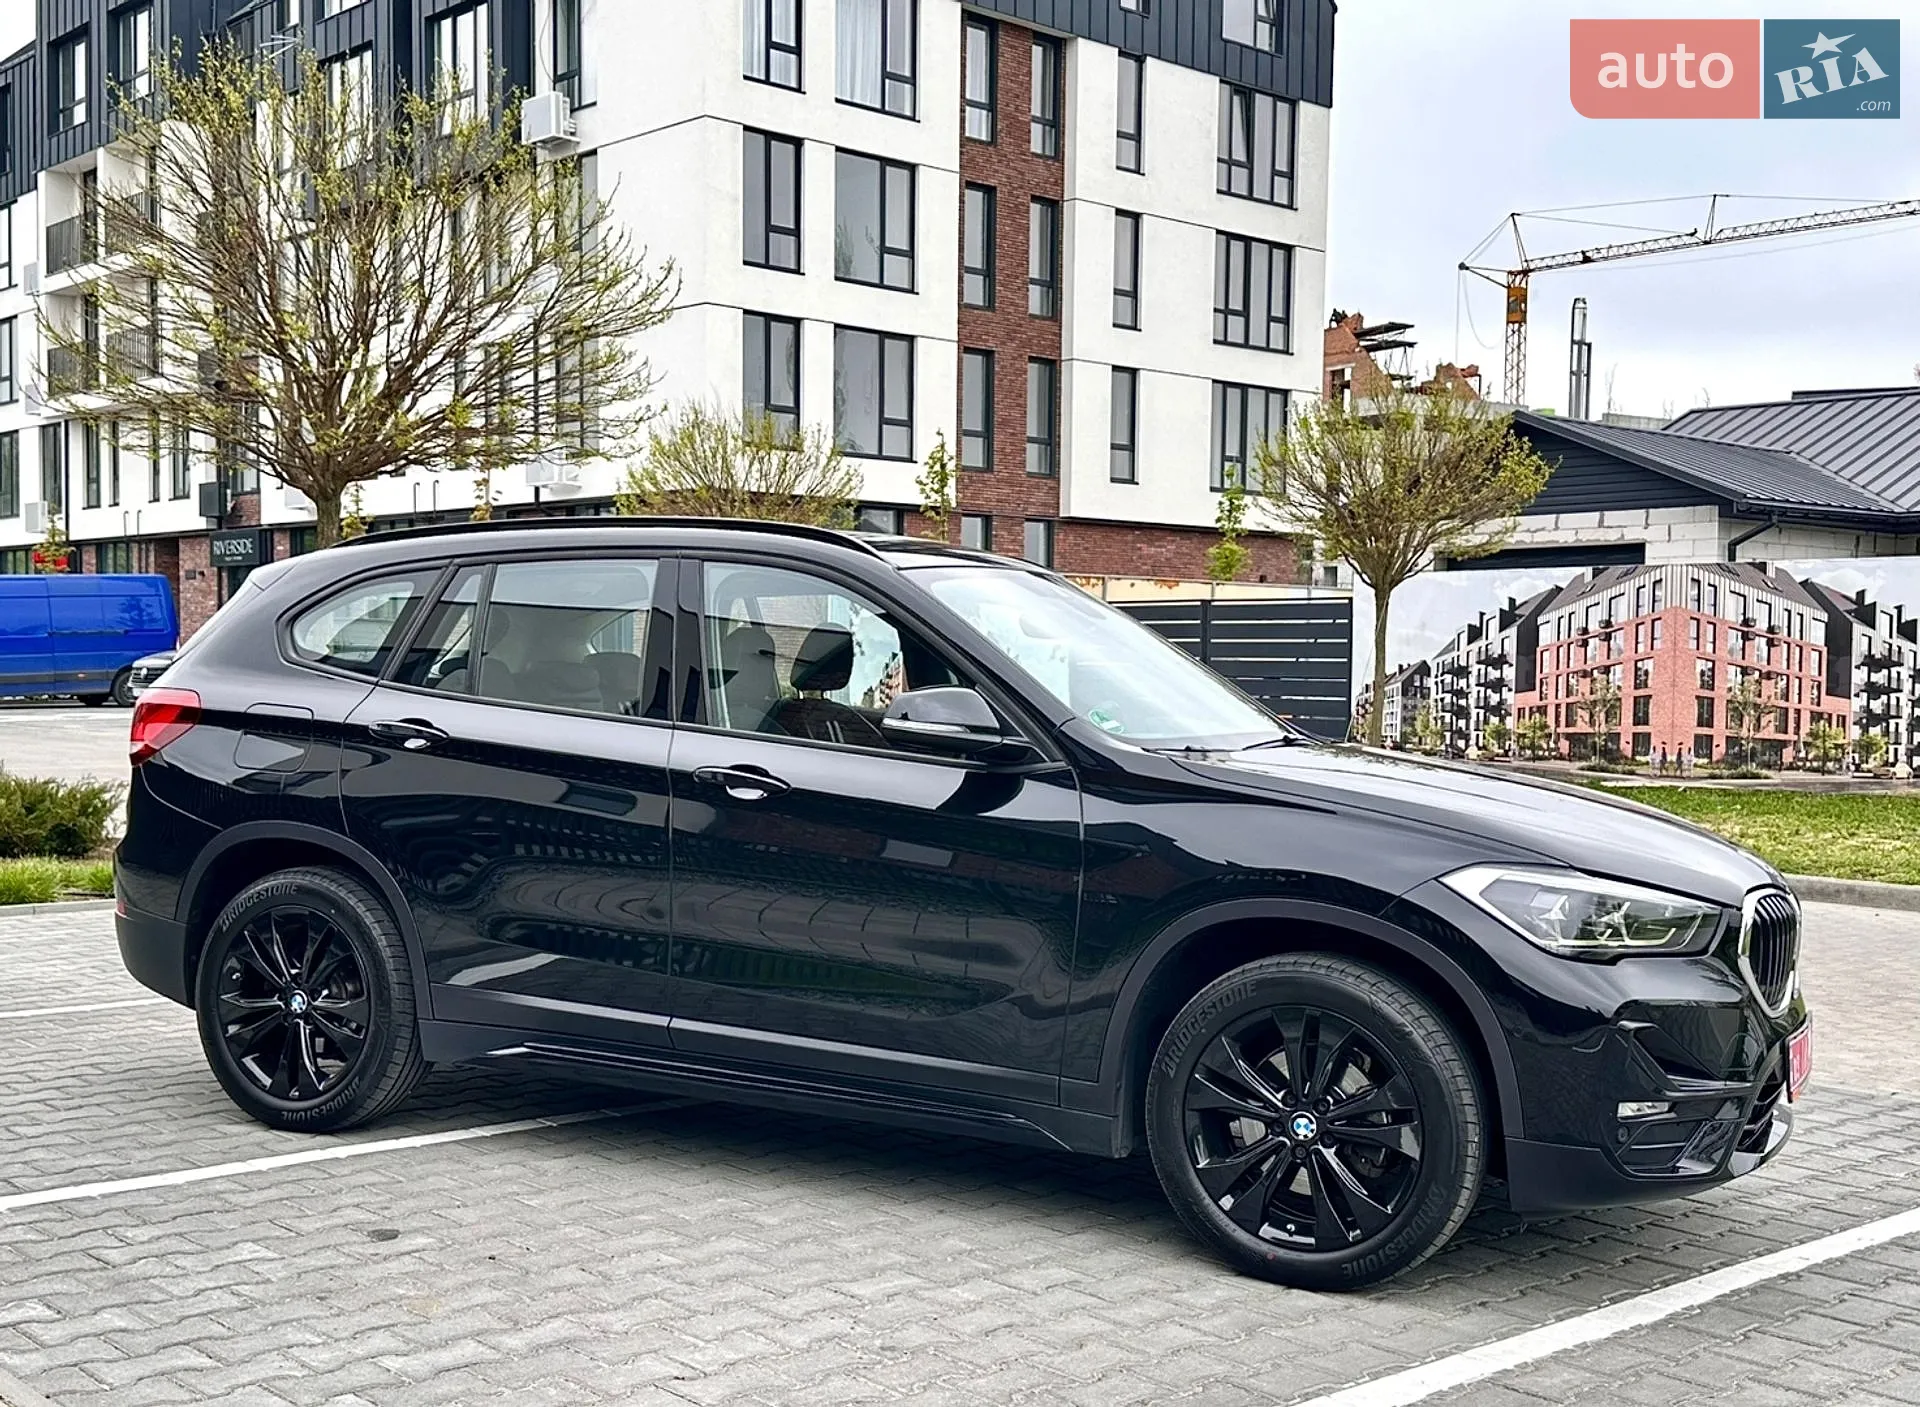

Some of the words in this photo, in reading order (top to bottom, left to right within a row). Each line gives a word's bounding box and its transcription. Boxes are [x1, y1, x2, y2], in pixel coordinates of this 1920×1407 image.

[213, 538, 254, 555] RIVERSIDE
[219, 882, 298, 933] BRIDGESTONE
[1160, 980, 1257, 1079] BRIDGESTONE
[281, 1076, 360, 1121] BRIDGESTONE
[1341, 1183, 1446, 1278] BRIDGESTONE
